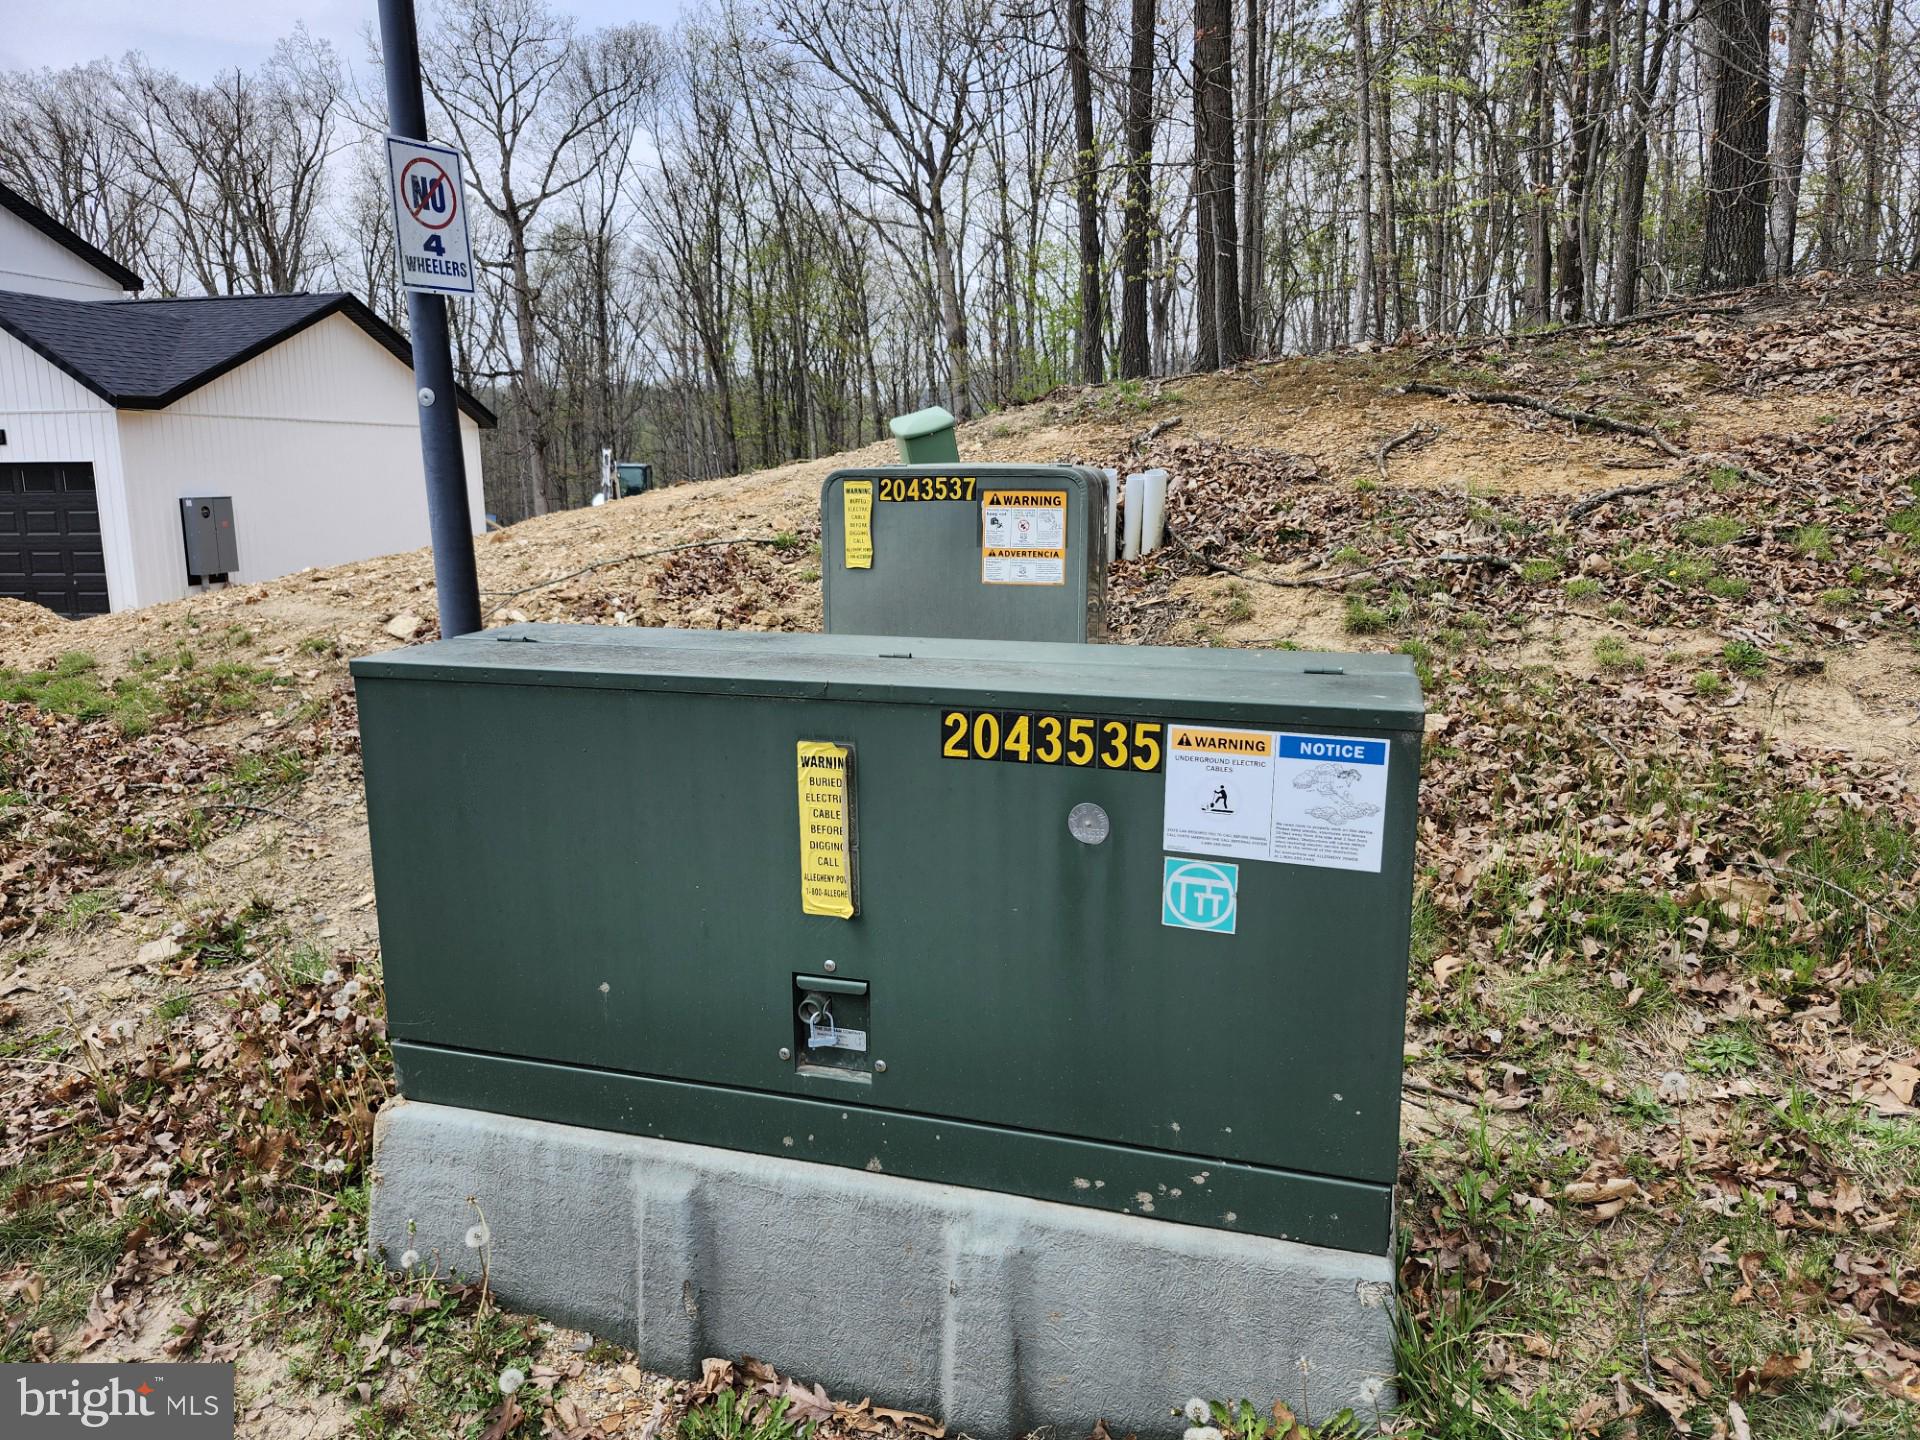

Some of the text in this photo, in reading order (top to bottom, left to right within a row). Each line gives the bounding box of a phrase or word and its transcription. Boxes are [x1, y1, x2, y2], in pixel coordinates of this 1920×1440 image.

[410, 174, 446, 214] NO
[423, 234, 446, 257] 4
[405, 255, 467, 278] WHEELERS
[880, 477, 976, 501] 2043537
[1003, 495, 1062, 506] WARNING
[998, 550, 1060, 559] ADVERTENCIA
[943, 712, 1161, 771] 2043535
[1195, 736, 1266, 752] WARNING
[1300, 742, 1365, 759] NOTICE
[801, 755, 844, 769] WARNIN
[1175, 754, 1266, 768] UNDERGROUND ELECTRIC
[1206, 765, 1234, 773] CABLES
[809, 776, 842, 788] BURIED
[805, 792, 842, 803] ELECTRI
[813, 808, 841, 820] CABLE
[817, 856, 840, 867] CALL
